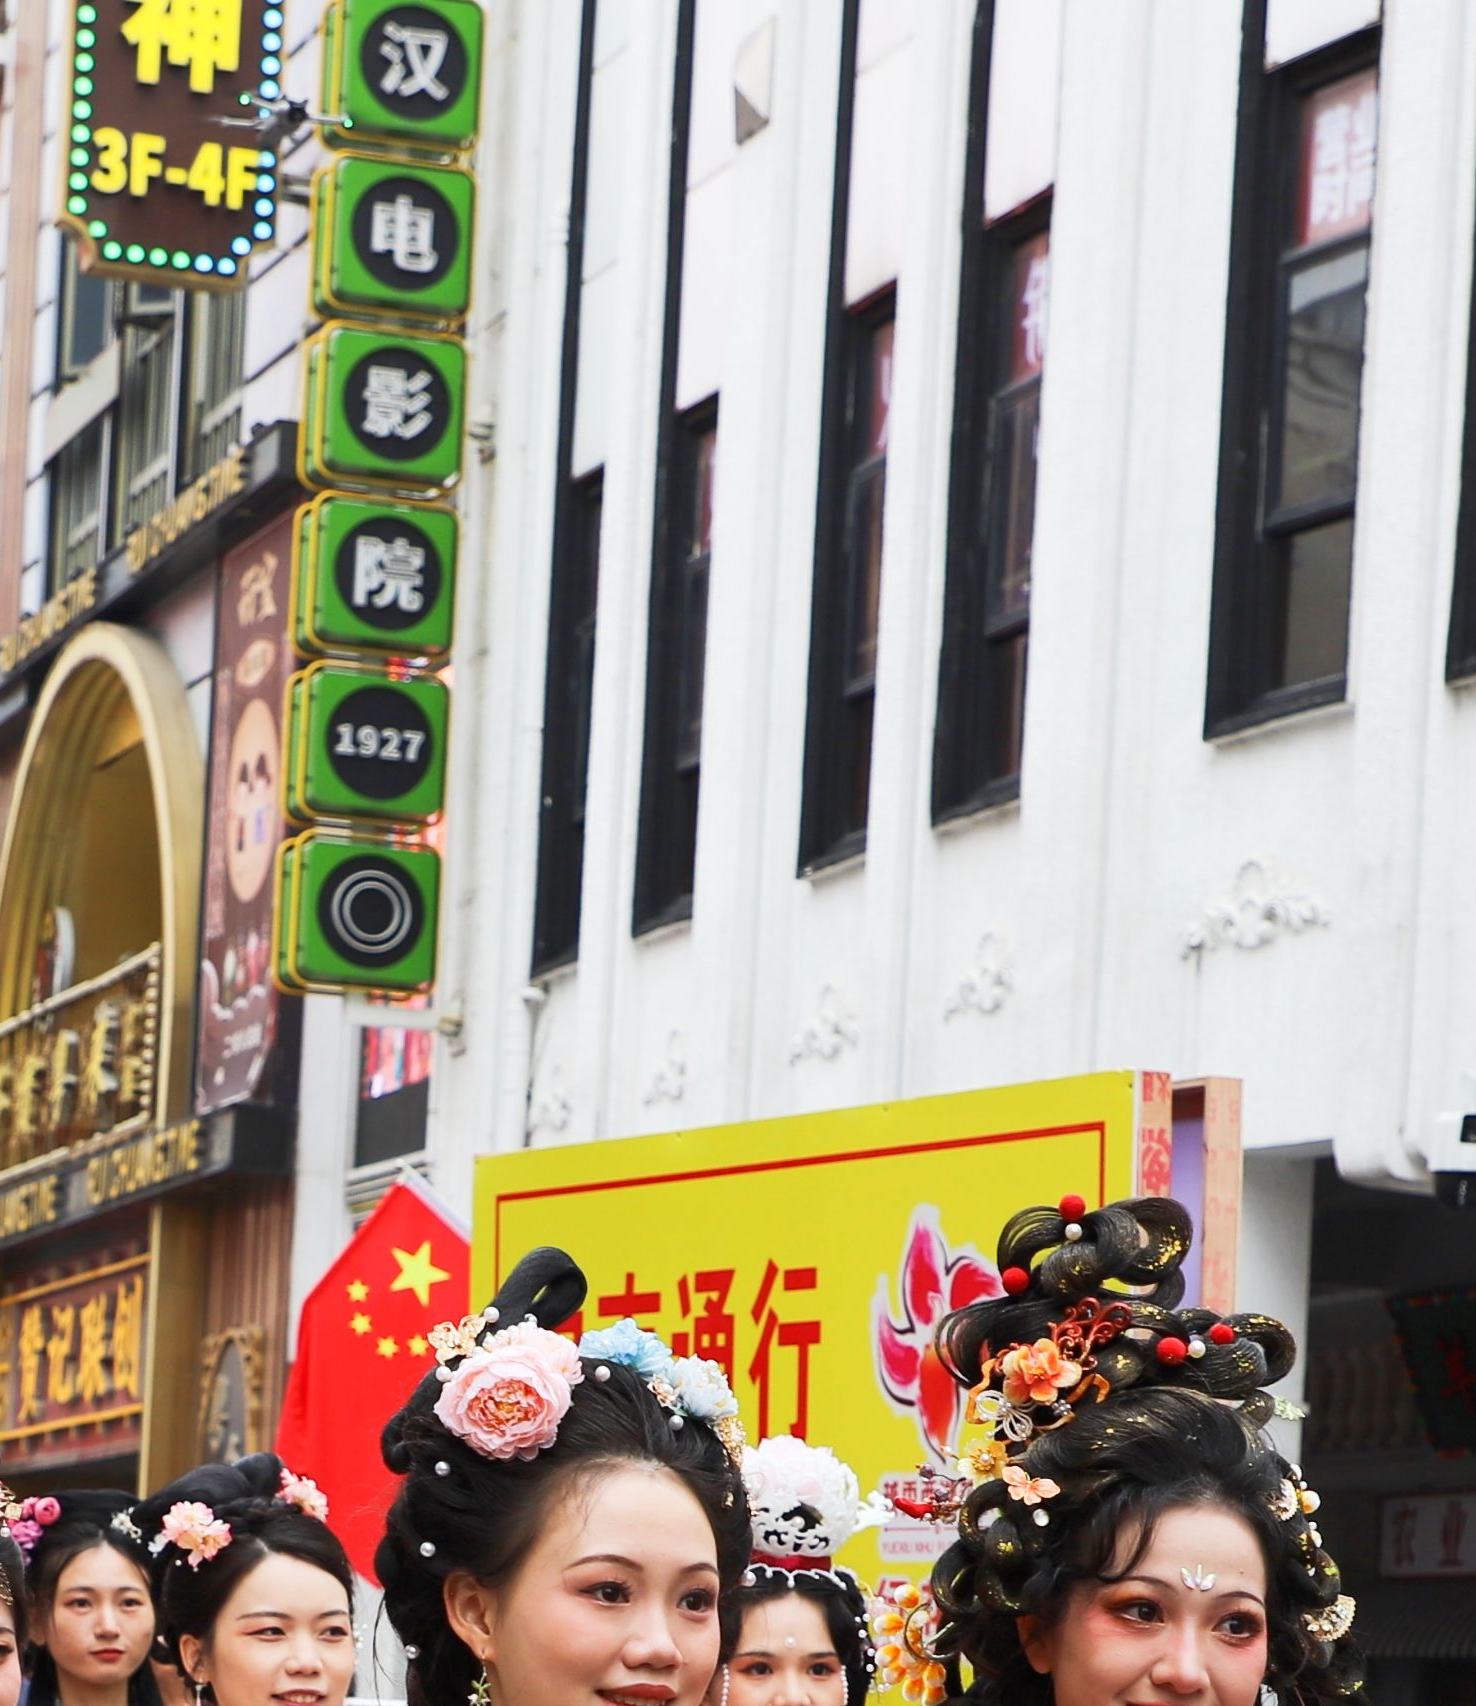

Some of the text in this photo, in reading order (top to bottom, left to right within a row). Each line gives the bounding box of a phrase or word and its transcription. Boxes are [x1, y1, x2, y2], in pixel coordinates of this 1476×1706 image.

[92, 127, 261, 212] 3F-4F
[353, 22, 449, 612] 汉电影院
[334, 722, 426, 763] 1927
